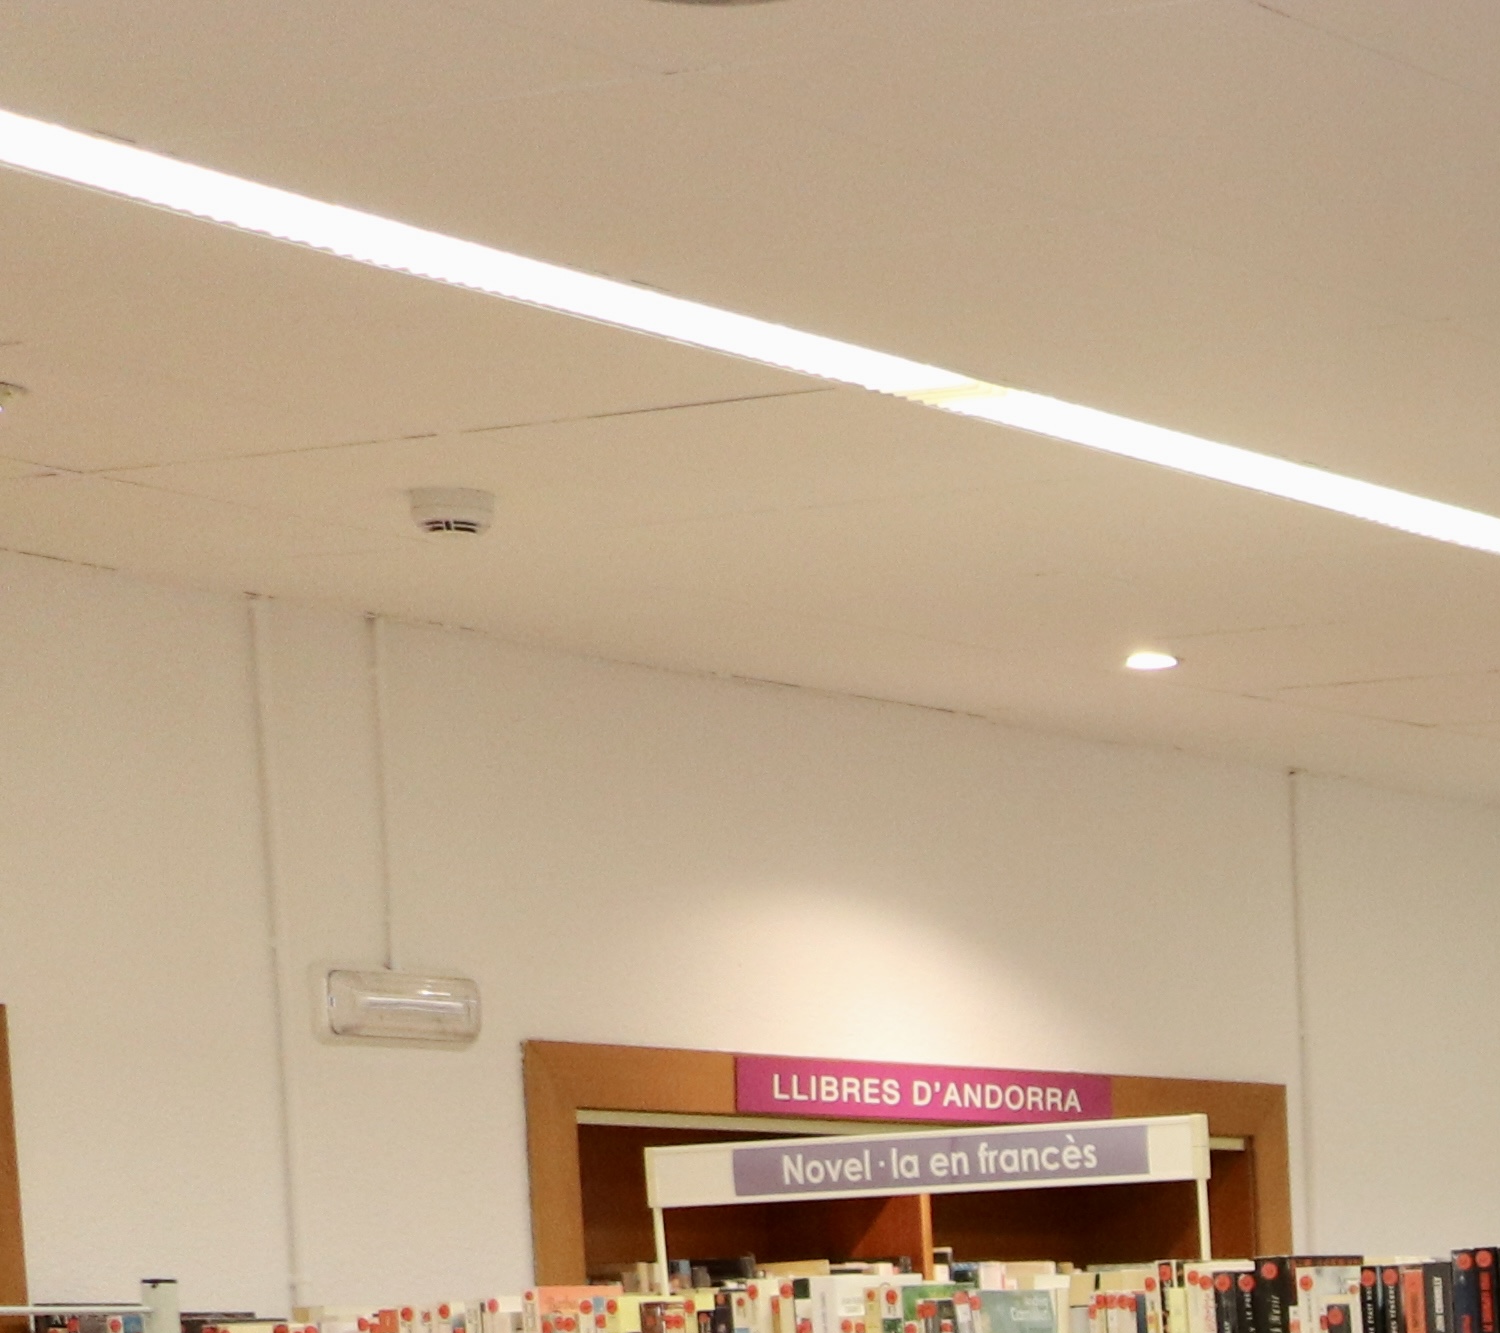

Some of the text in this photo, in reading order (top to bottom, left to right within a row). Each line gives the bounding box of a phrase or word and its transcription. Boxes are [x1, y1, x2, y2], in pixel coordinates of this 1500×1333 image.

[772, 1073, 1083, 1113] LLIBRES D'ANDORRA
[930, 1151, 970, 1177] en
[978, 1134, 1098, 1173] francès
